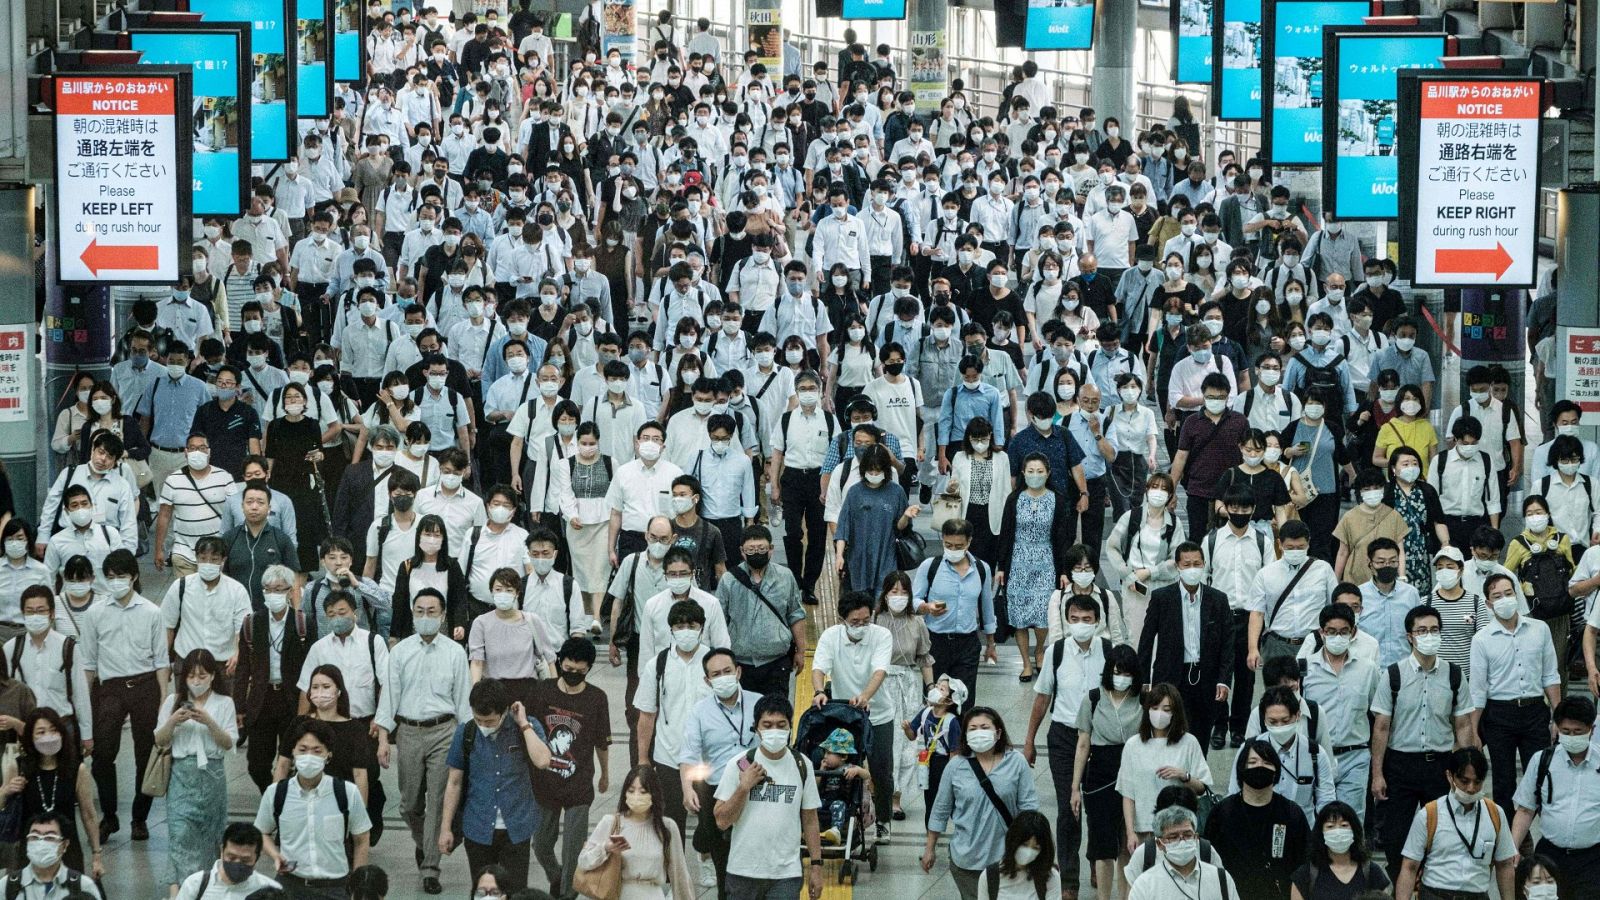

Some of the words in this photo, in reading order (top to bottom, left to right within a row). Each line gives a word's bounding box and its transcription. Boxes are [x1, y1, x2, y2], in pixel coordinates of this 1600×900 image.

[750, 12, 772, 23] 秋田
[912, 33, 936, 46] 山形
[62, 81, 168, 94] 品川駅からのおねがい
[1427, 86, 1534, 98] 品川駅からのおねがい
[92, 100, 138, 111] NOTICE
[1457, 104, 1503, 115] NOTICE
[73, 118, 159, 135] 朝の混雑時は
[1437, 122, 1522, 139] 朝の混雑時は
[77, 139, 155, 157] 通路左端を
[1439, 143, 1517, 161] 通路右端を
[67, 162, 167, 178] ご通行ください
[1428, 166, 1527, 182] ご通行ください
[99, 185, 136, 197] Please
[1459, 189, 1495, 200] Please
[82, 202, 118, 215] KEEP
[121, 202, 154, 215] LEFT
[1437, 206, 1472, 219] KEEP
[1475, 206, 1516, 219] RIGHT
[75, 221, 108, 235] duing
[111, 221, 134, 233] rush
[137, 221, 161, 233] hour
[1432, 225, 1465, 239] during
[1469, 225, 1492, 237] rush
[1495, 225, 1519, 237] hour
